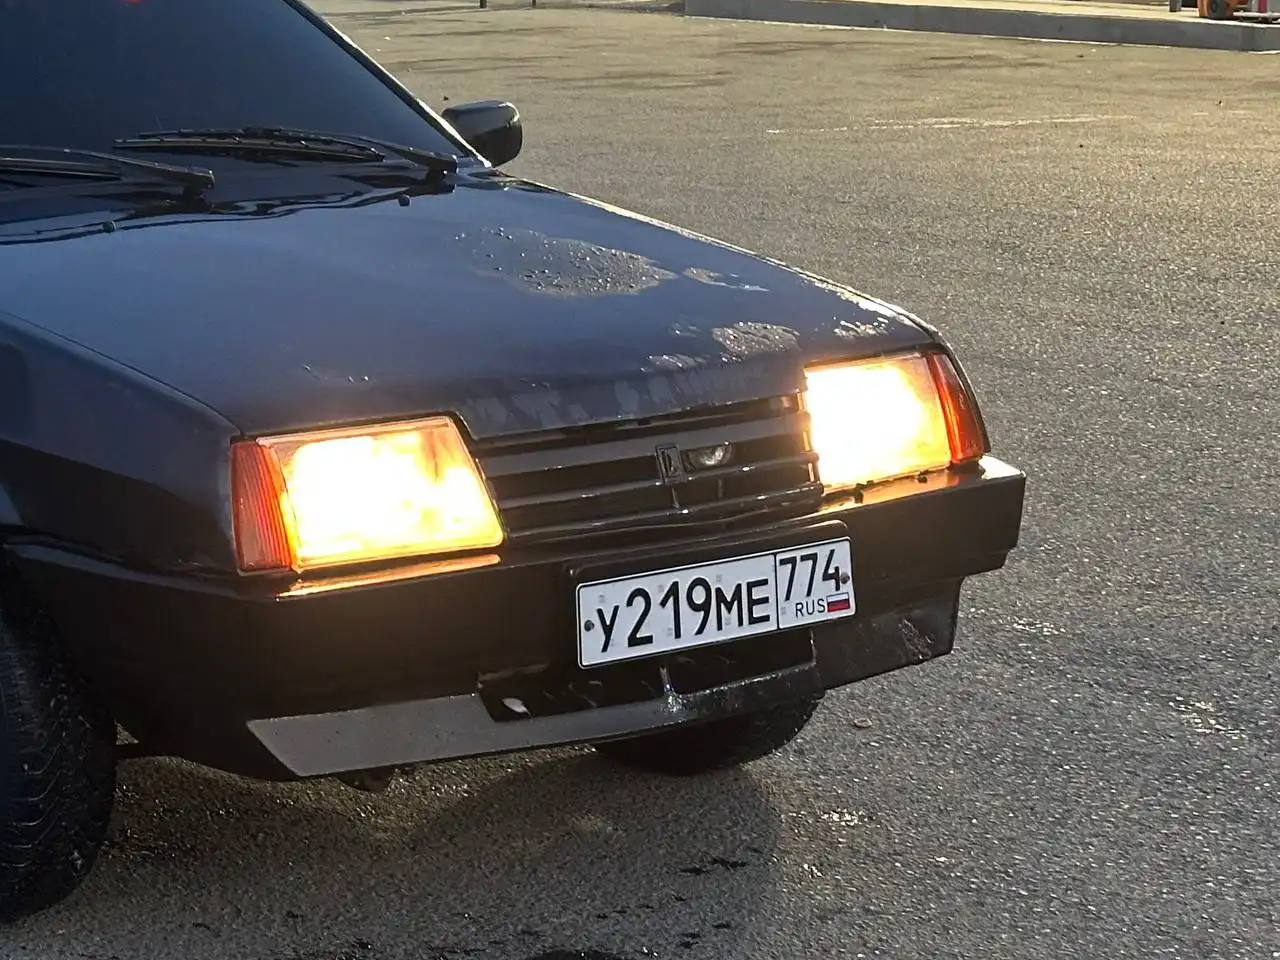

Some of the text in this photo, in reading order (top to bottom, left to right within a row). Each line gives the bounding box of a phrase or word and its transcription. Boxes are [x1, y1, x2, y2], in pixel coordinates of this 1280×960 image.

[596, 548, 841, 654] У219МЕ 774
[795, 598, 826, 618] RUS
